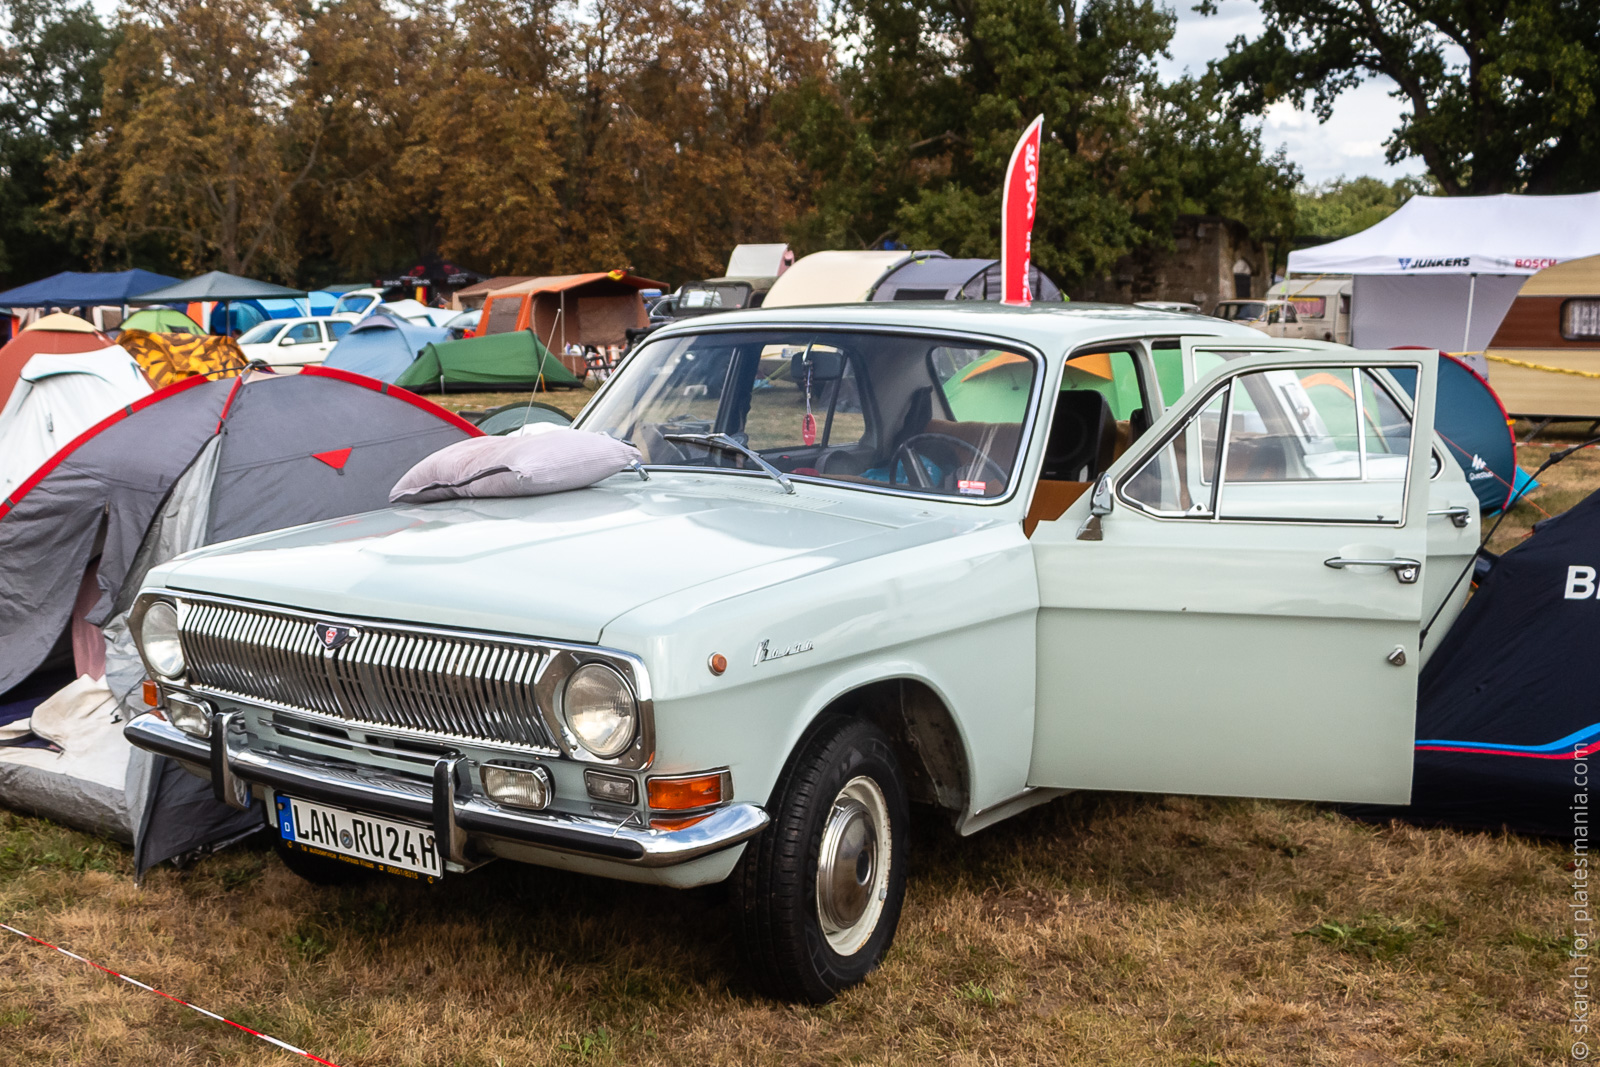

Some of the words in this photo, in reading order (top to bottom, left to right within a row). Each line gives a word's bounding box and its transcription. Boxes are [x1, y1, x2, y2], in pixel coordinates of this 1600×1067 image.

[1411, 257, 1470, 268] JUNKERS
[1514, 258, 1557, 269] BOSCH
[1564, 565, 1600, 600] B
[293, 804, 339, 848] LAN
[352, 818, 437, 870] RU24H
